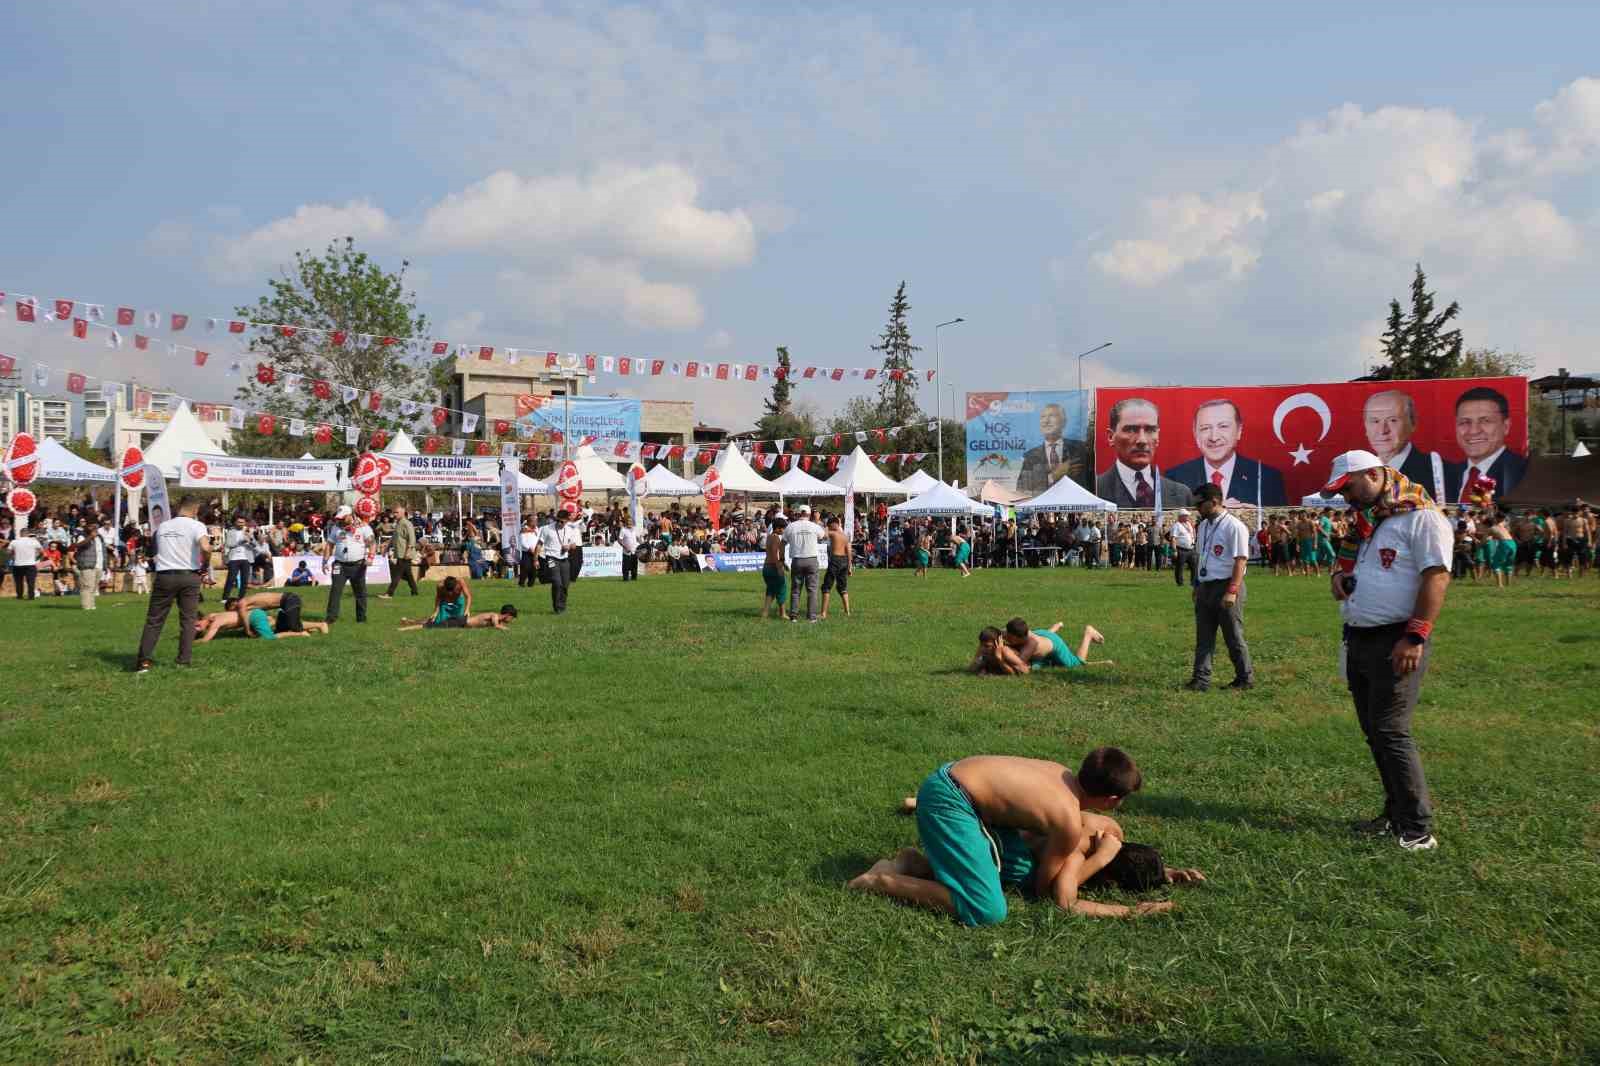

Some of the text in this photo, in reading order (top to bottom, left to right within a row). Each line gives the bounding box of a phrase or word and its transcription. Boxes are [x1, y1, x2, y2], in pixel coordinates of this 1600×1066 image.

[984, 422, 1010, 436] HOŞ
[969, 436, 1026, 452] GELDİNİZ
[409, 455, 473, 469] HOŞ GELDİNİZ
